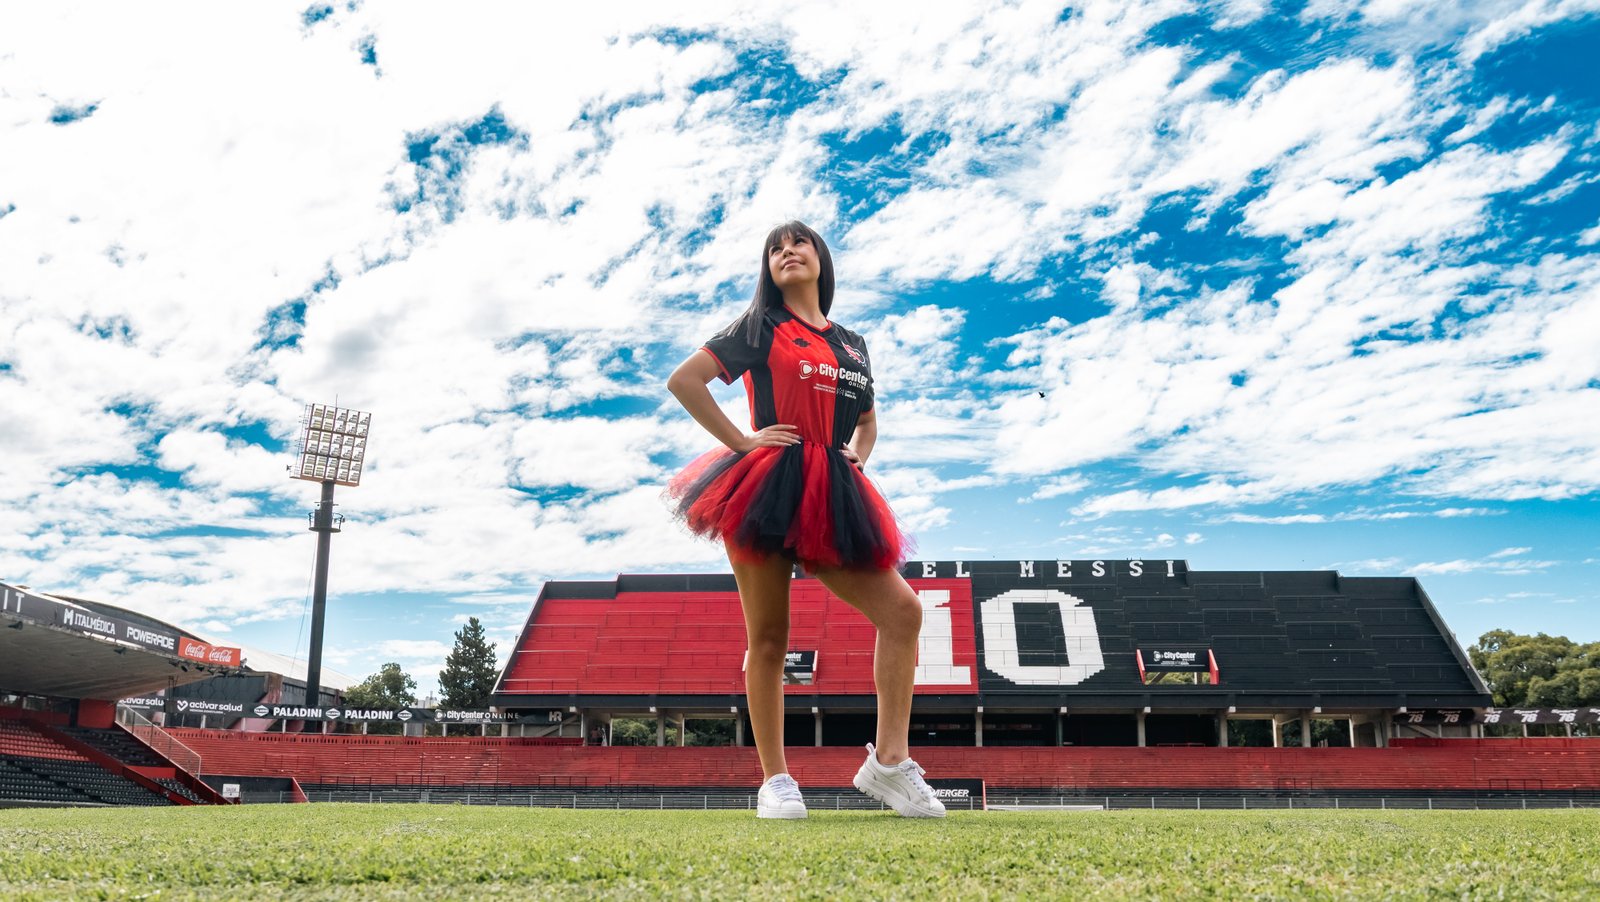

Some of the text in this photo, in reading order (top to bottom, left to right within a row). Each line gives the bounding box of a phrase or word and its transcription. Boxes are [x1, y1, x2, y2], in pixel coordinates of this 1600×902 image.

[1020, 560, 1175, 577] MESSI
[75, 613, 116, 635] ITALMÉDICA
[126, 626, 175, 650] POWERADE
[189, 700, 219, 710] activar
[218, 703, 243, 713] salud
[273, 706, 322, 718] PALADINI
[344, 709, 393, 720] PALADINI
[1408, 713, 1424, 723] 78
[1444, 713, 1460, 723] 78
[1483, 713, 1501, 724] 78
[1521, 712, 1538, 723] 78
[1558, 712, 1576, 723] 78
